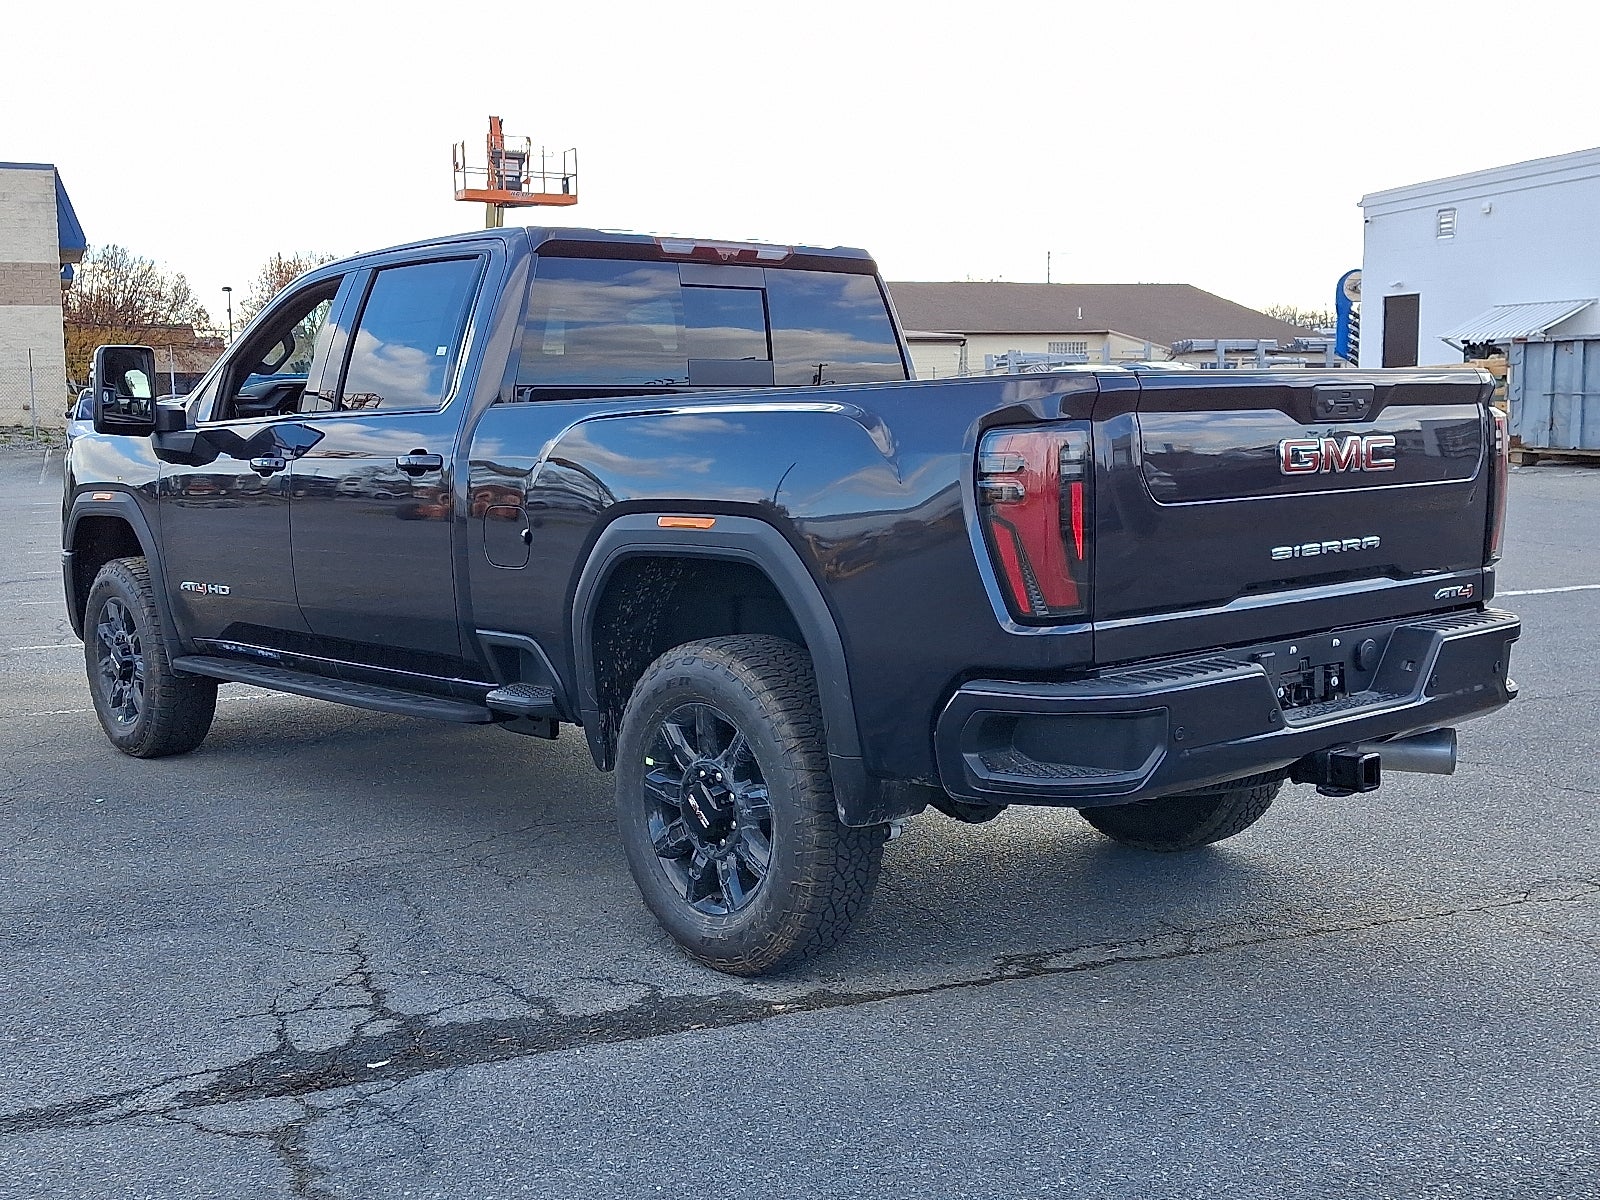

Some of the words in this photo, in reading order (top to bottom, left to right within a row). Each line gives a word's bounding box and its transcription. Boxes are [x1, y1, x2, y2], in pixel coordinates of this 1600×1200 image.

[1279, 435, 1396, 475] GMC
[1271, 535, 1381, 560] SIERRA
[1434, 583, 1474, 600] AT4
